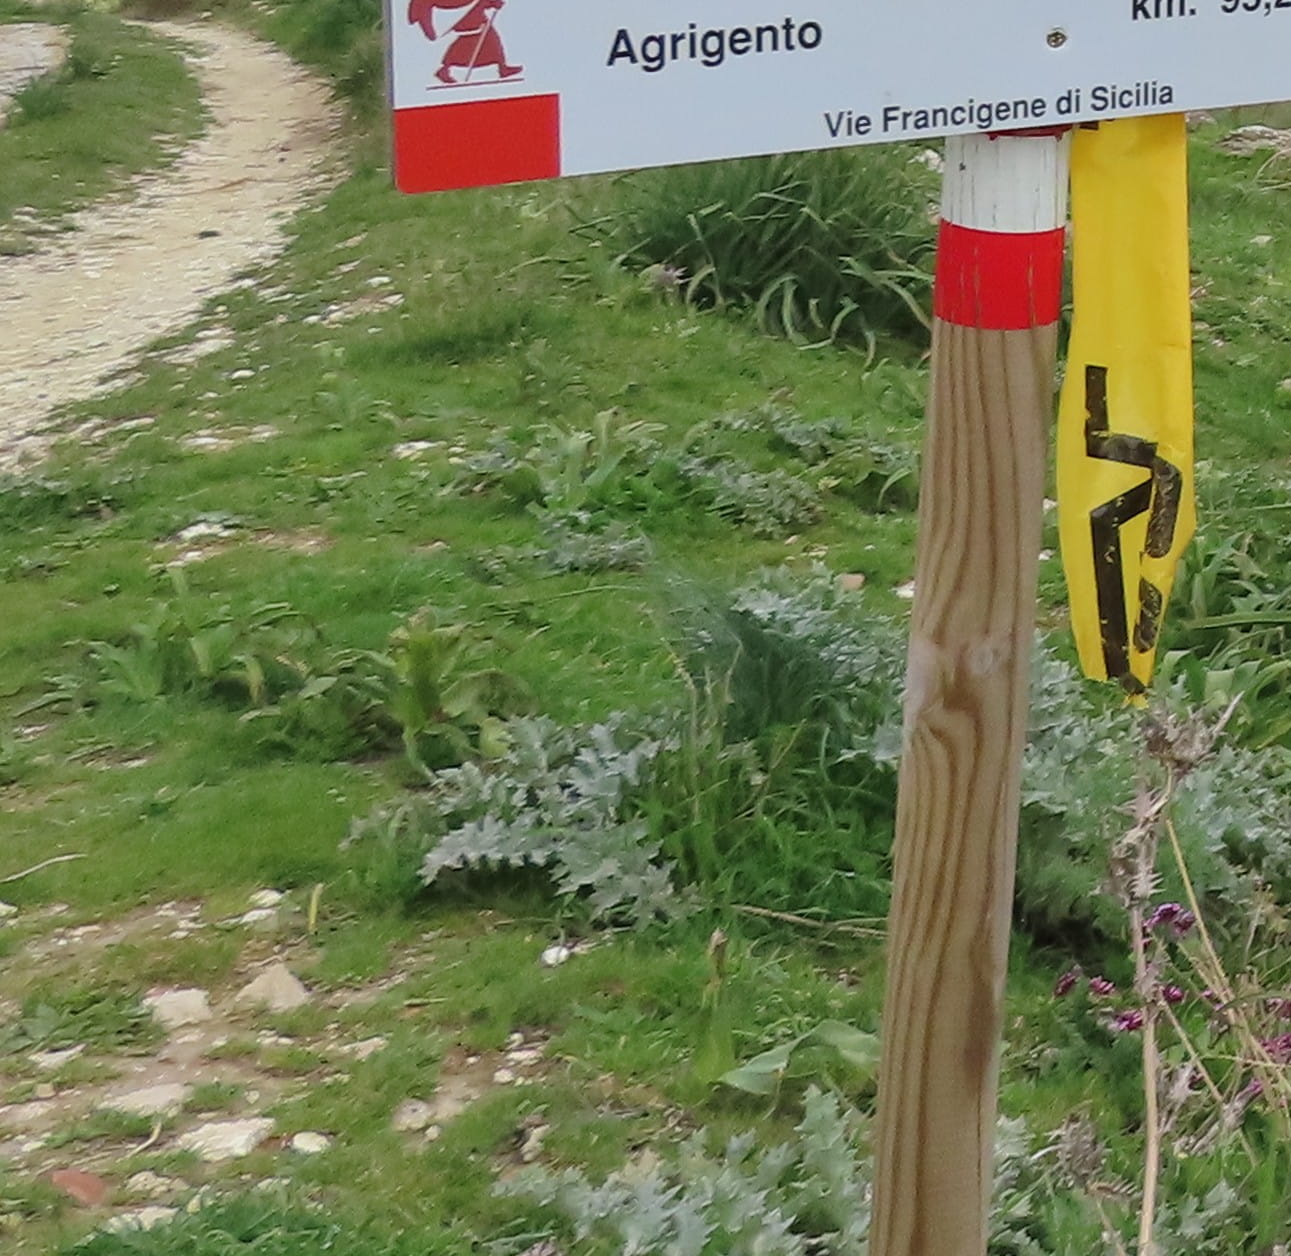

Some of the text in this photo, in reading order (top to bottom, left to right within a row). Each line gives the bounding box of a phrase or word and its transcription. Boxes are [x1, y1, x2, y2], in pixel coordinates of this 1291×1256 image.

[606, 17, 822, 73] Agrigento
[824, 81, 1173, 138] Vie Francigene di Sicilia
